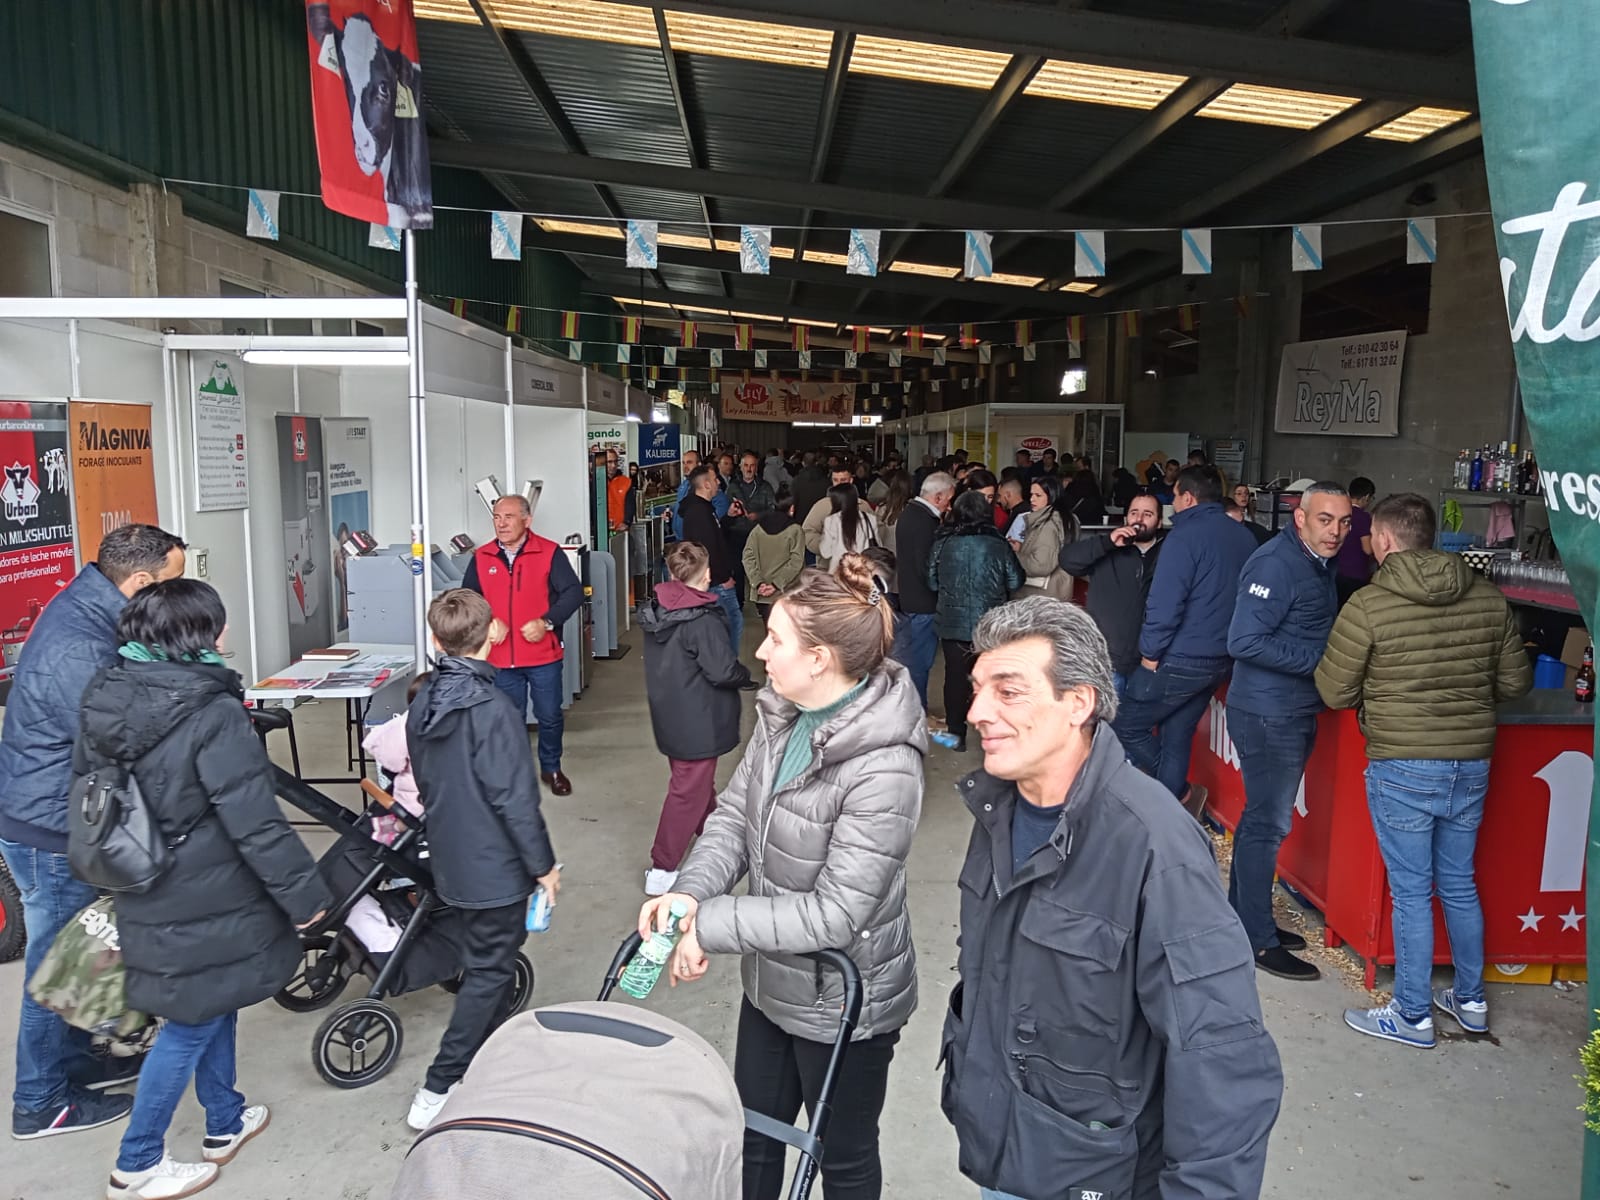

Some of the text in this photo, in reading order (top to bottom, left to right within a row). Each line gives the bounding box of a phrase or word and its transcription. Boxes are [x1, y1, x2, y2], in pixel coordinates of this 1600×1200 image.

[1294, 378, 1381, 431] ReyMa
[79, 421, 151, 451] MAGNIVA
[645, 449, 676, 458] KALIBER
[79, 456, 142, 468] FORAGE INOCULANTS
[7, 502, 37, 518] Urban
[9, 525, 72, 544] MILKSHUTTLE
[30, 550, 49, 562] leche
[1248, 583, 1271, 599] HH
